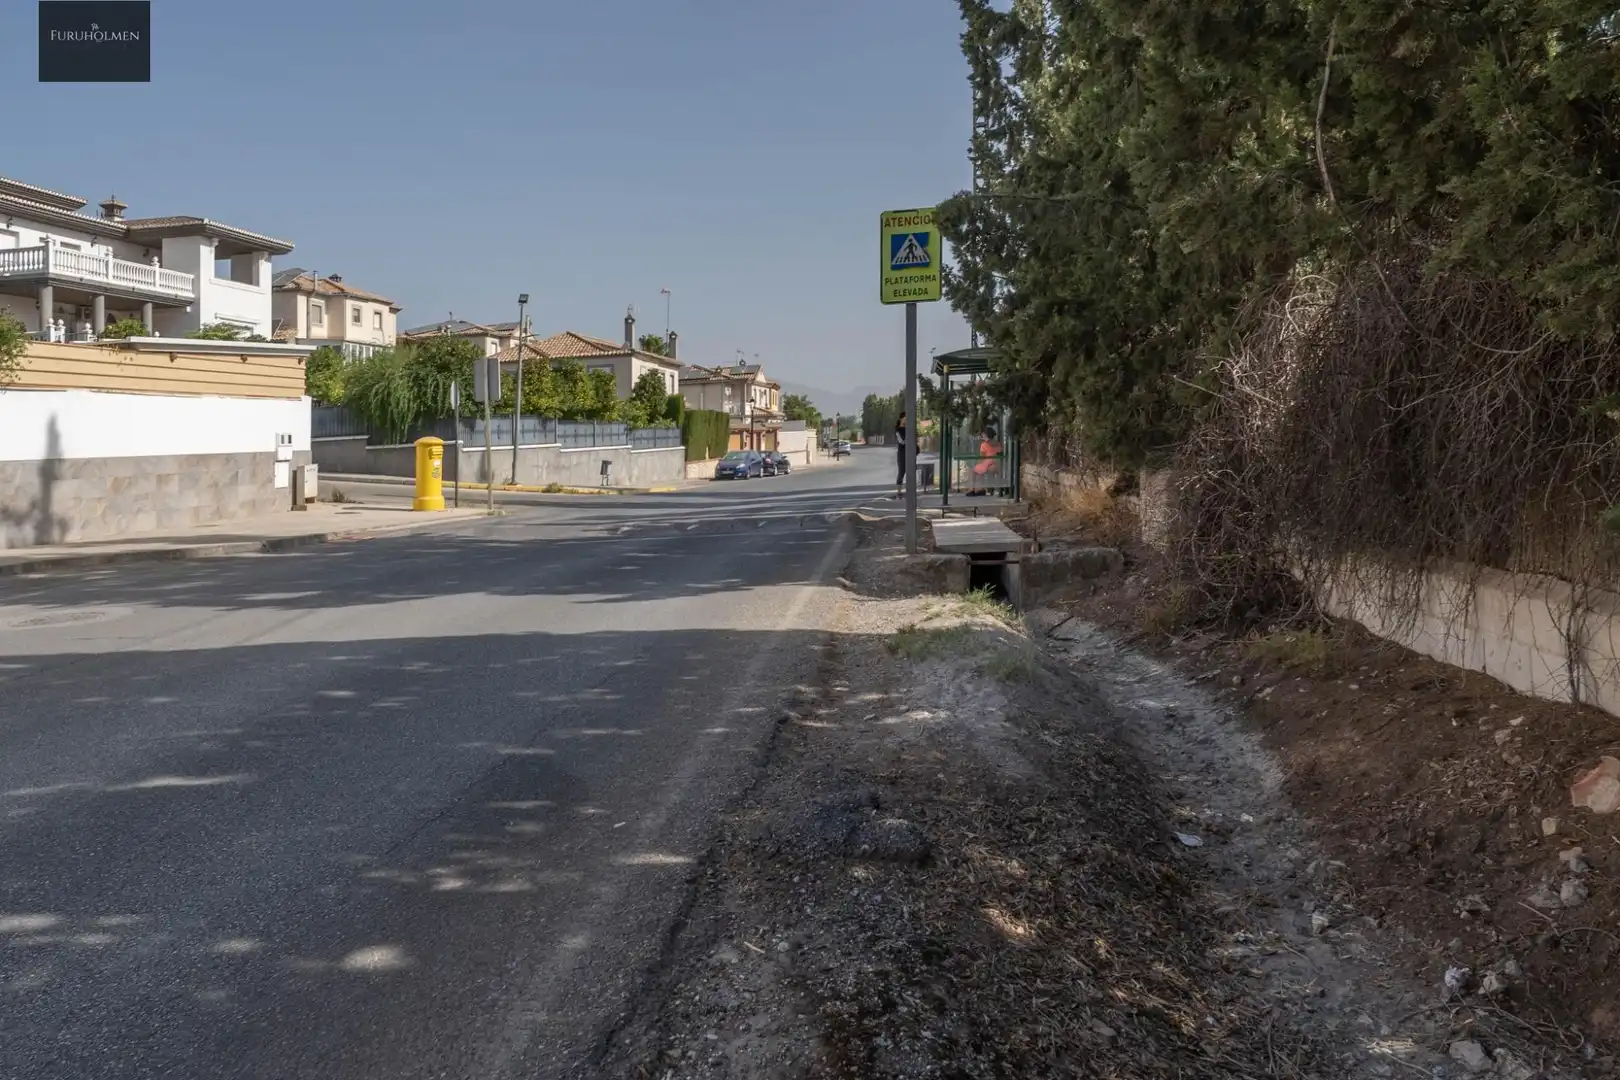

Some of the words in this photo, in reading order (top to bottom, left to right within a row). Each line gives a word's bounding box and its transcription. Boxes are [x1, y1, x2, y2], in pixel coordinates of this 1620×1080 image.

[884, 215, 935, 228] ATENCIO
[884, 274, 937, 286] PLATAFORMA
[893, 287, 929, 297] ELEVADA
